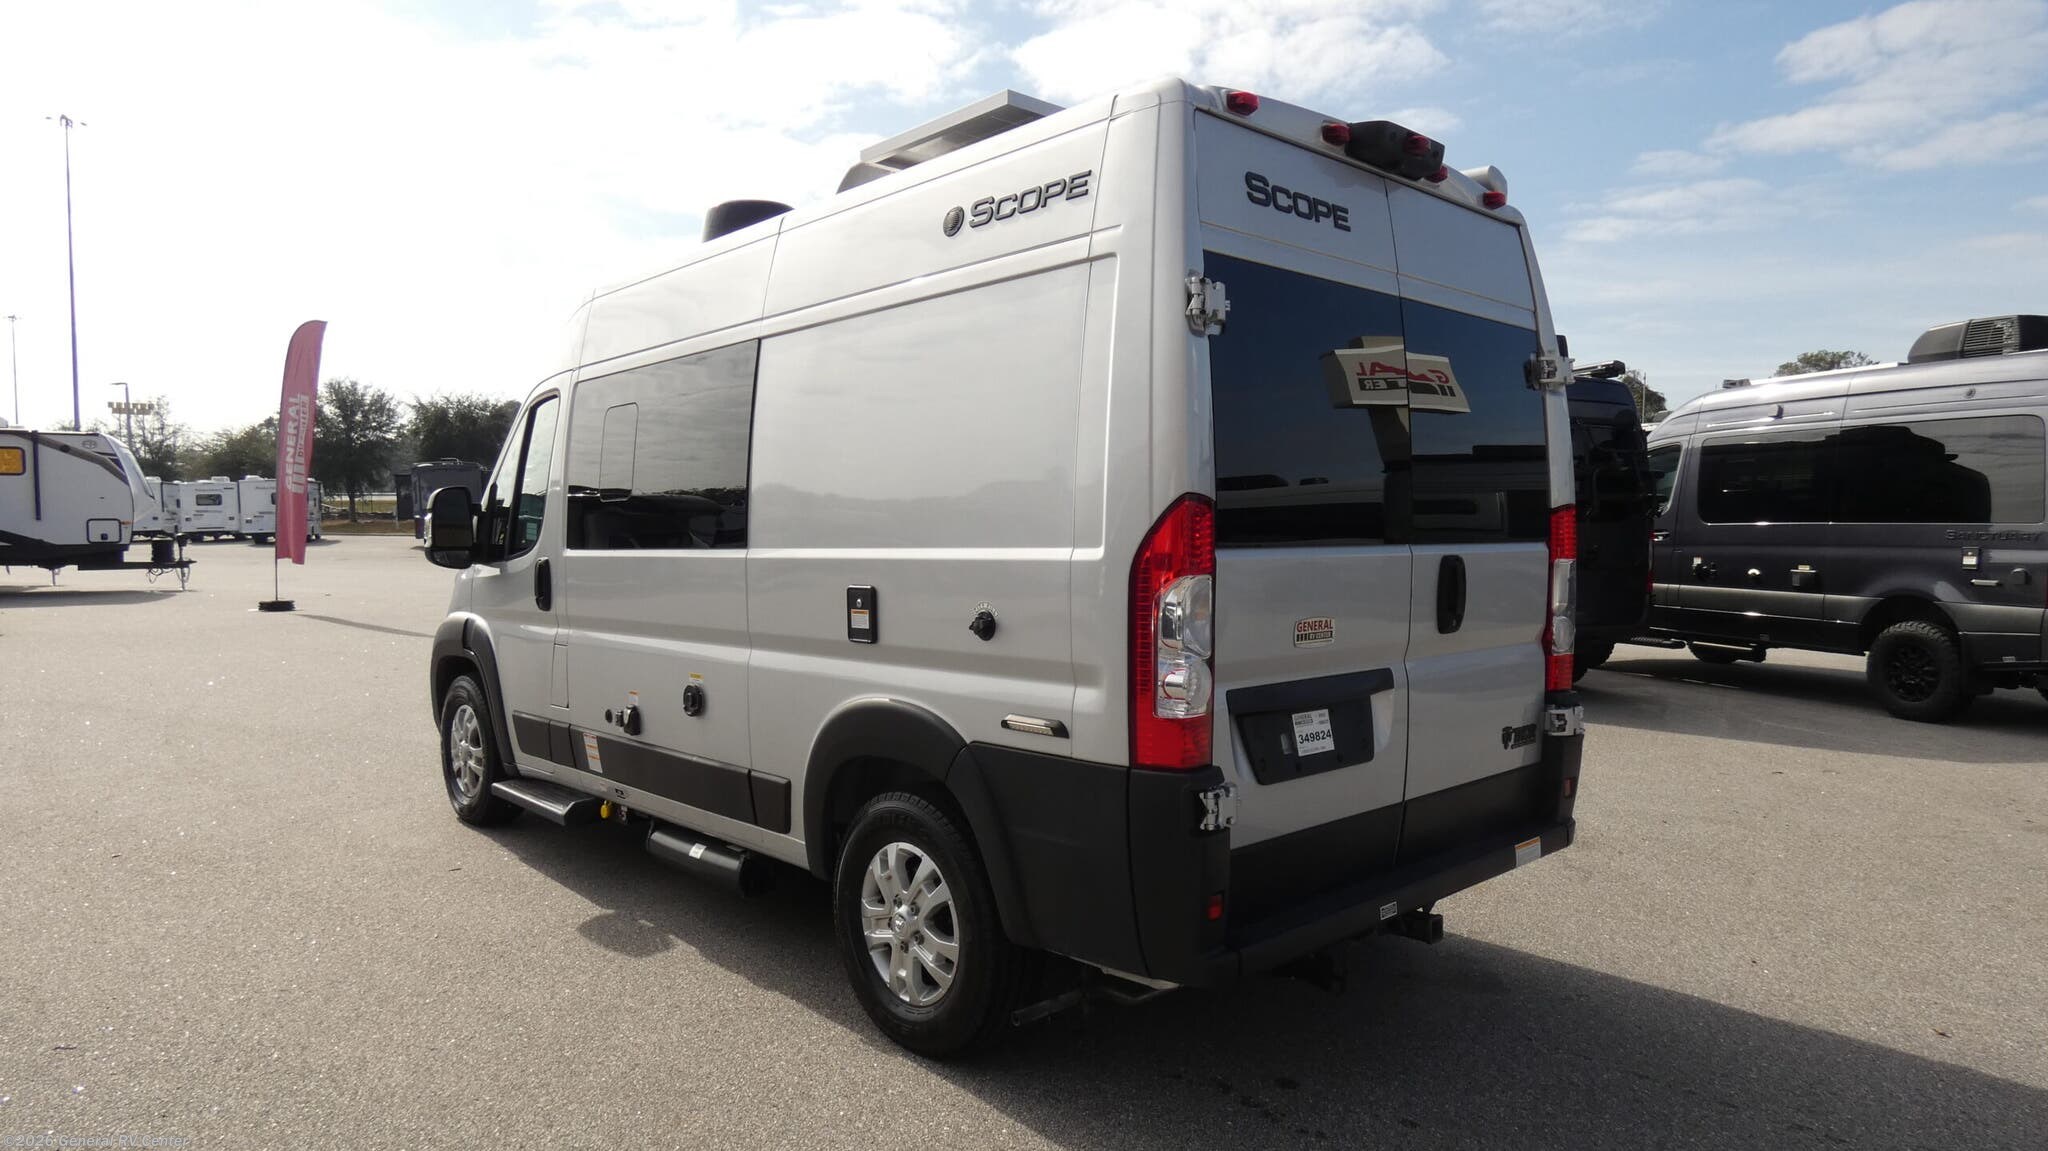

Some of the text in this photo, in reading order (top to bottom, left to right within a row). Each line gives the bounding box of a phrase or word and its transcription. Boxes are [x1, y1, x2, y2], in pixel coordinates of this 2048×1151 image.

[969, 169, 1092, 228] SCOPE
[1245, 171, 1351, 232] SCOPE
[285, 393, 301, 491] GENERAL
[1296, 619, 1333, 633] GENERAL
[1298, 729, 1332, 744] 349824
